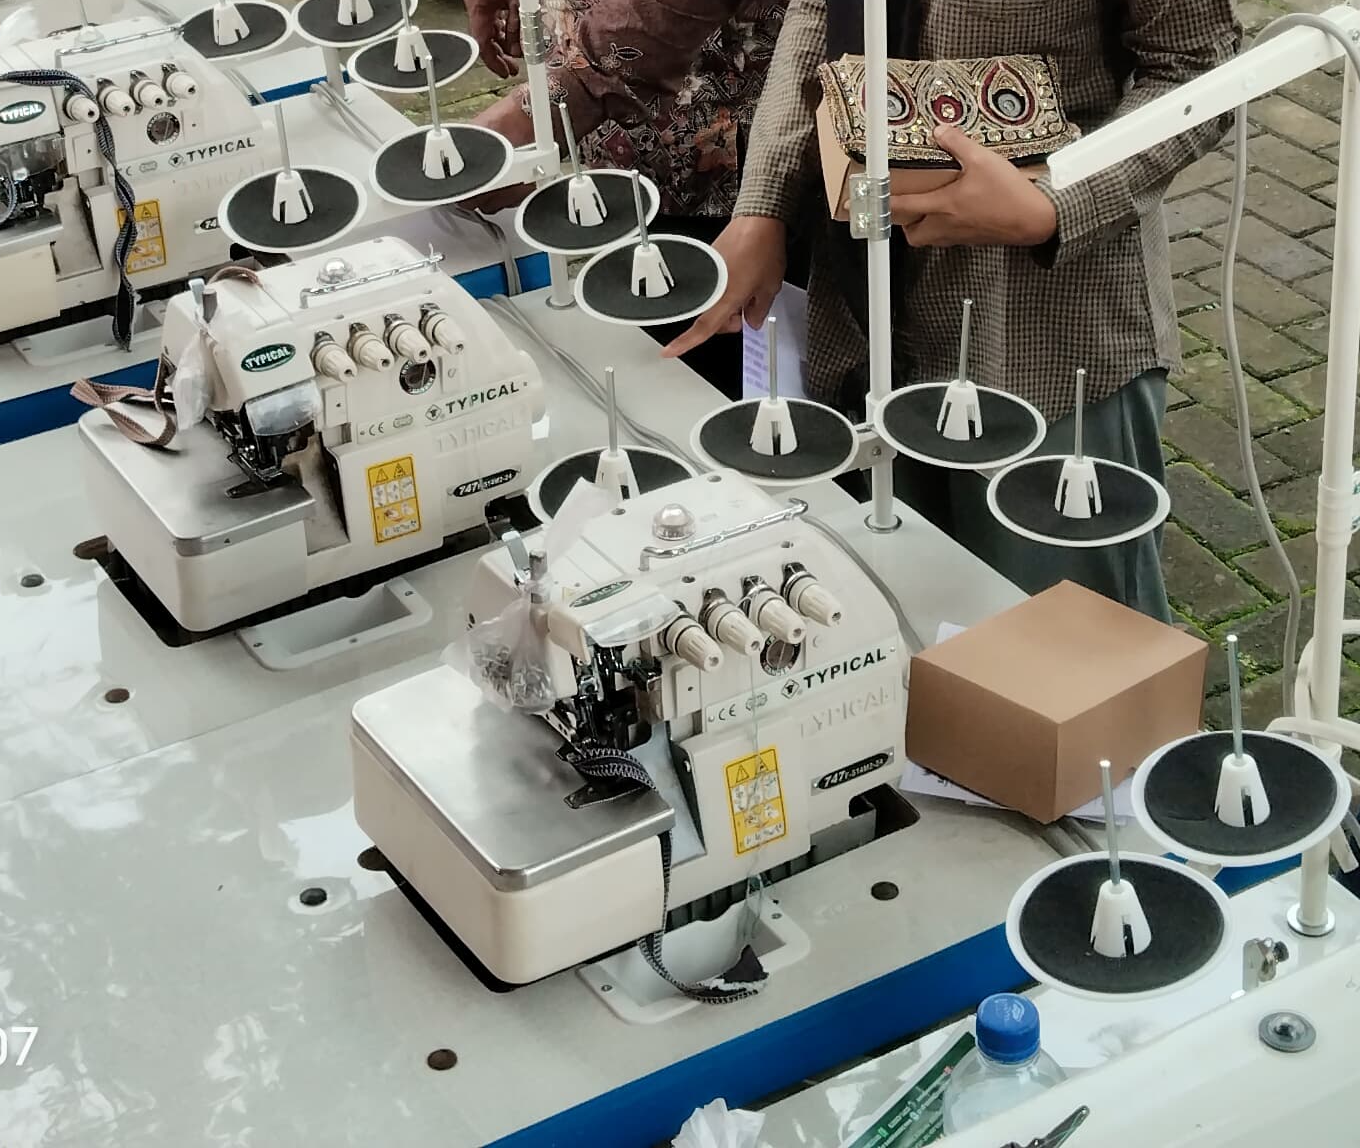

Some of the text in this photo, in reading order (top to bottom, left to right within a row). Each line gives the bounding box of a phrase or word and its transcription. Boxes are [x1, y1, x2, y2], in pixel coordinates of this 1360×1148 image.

[0, 103, 42, 121] TYPICAL
[186, 136, 256, 163] TYPICAL
[244, 347, 293, 369] TYPICAL
[445, 381, 519, 415] TYPICAL
[803, 648, 887, 689] TYPICAL
[718, 705, 737, 721] CE
